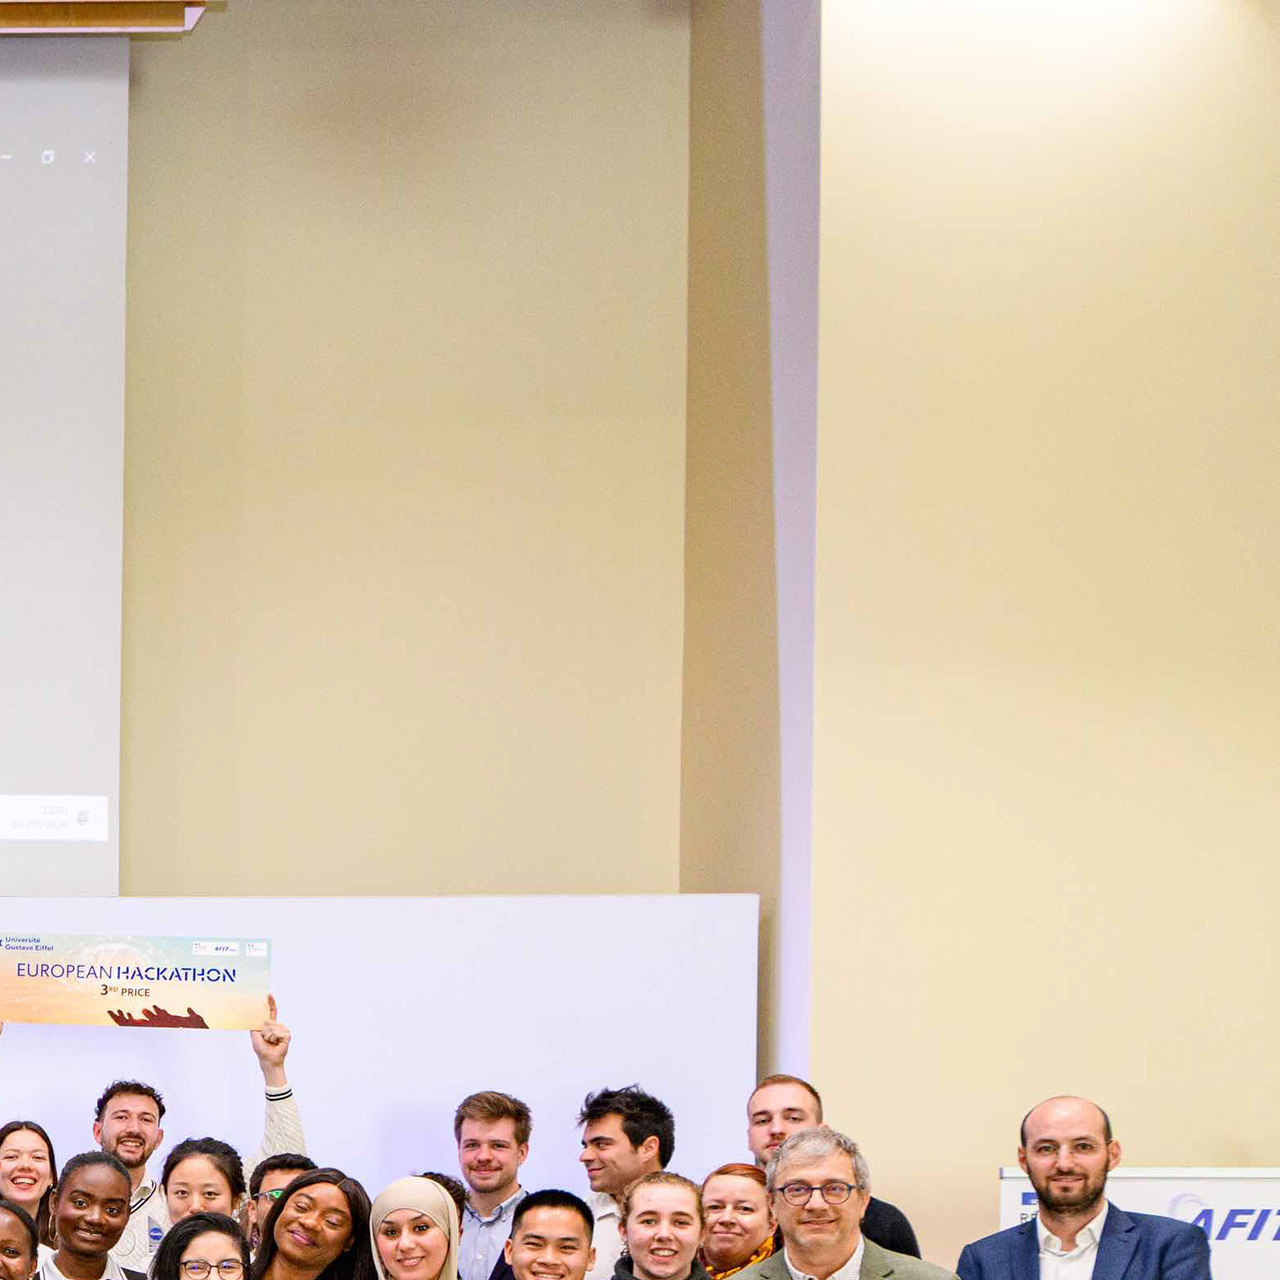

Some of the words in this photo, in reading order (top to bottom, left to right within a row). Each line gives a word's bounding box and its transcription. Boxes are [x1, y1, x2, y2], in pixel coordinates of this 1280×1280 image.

[17, 963, 112, 979] EUROPEAN
[117, 966, 236, 982] HACKATHON
[121, 988, 150, 997] PRICE
